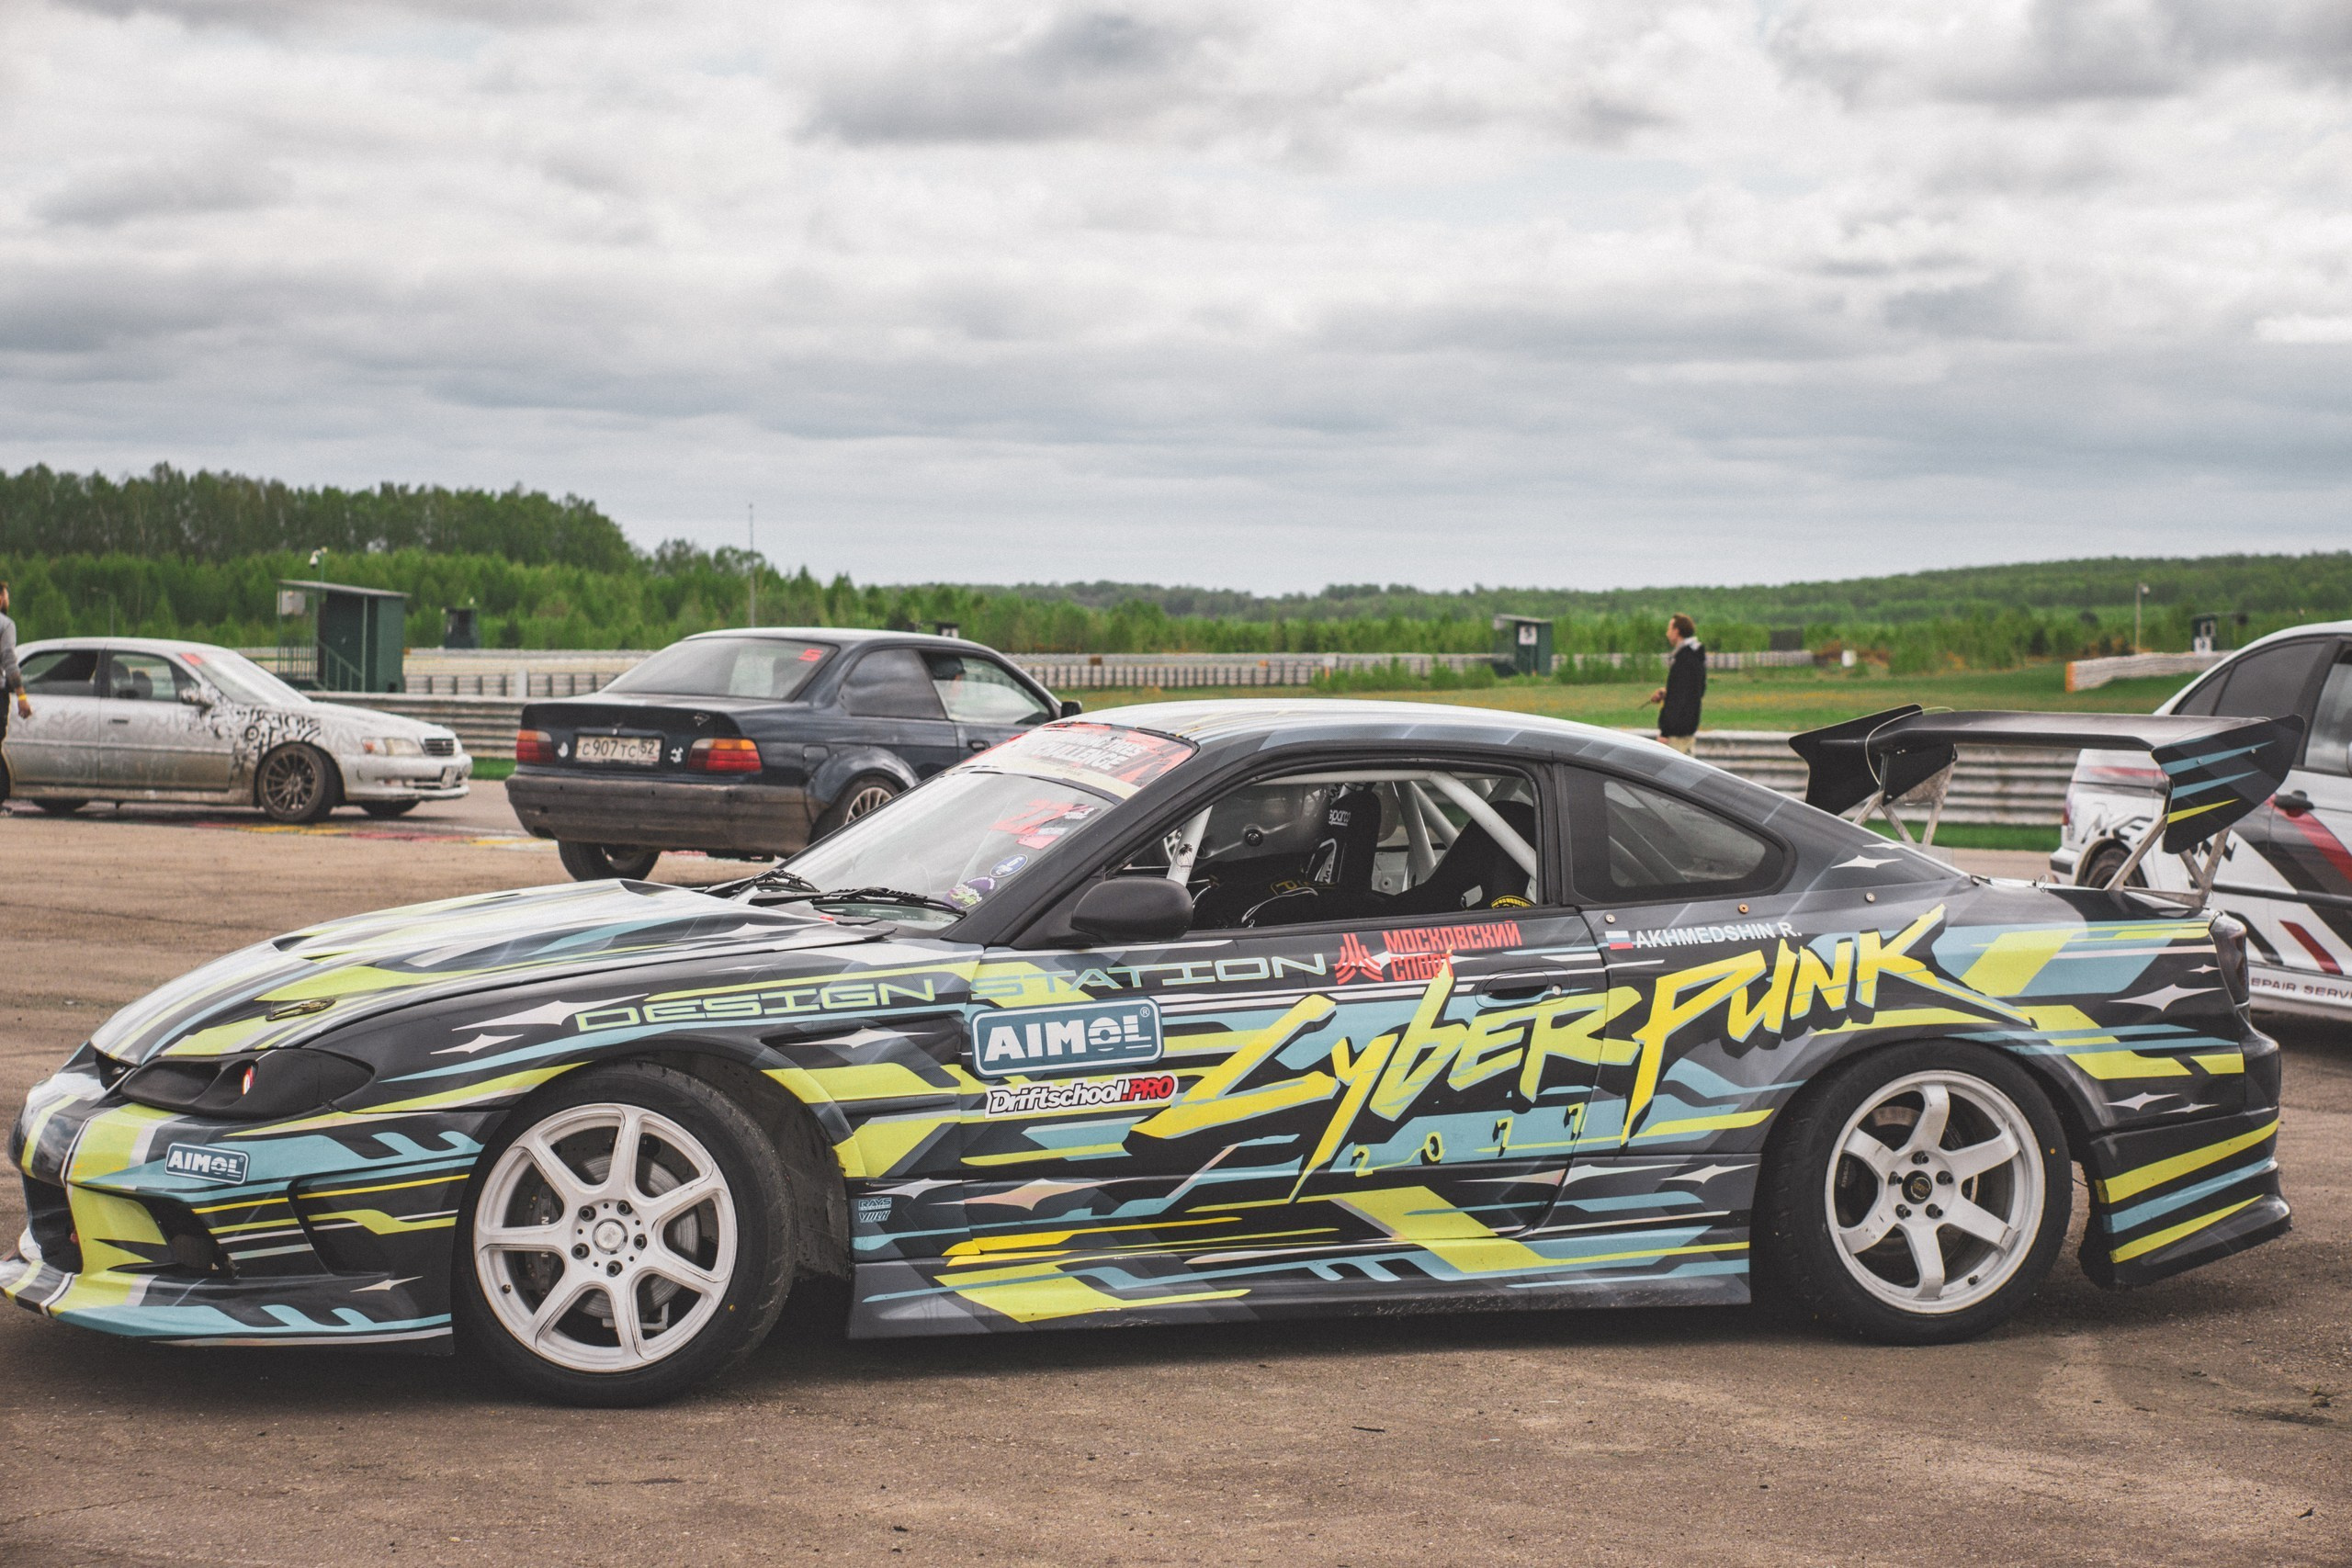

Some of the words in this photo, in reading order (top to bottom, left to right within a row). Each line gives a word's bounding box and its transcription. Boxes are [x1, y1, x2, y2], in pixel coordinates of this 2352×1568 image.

[1383, 920, 1522, 953] МОСКОВСКИЙ
[1636, 922, 1776, 948] AKHMEDSHIN
[1777, 921, 1803, 938] R.
[1390, 953, 1453, 981] СПОРТ
[575, 979, 935, 1032] DESIGN
[970, 953, 1327, 1000] STATION
[984, 1015, 1152, 1062] AIMOL
[989, 1076, 1175, 1114] Driftschool.PRO
[168, 1150, 242, 1178] AIMOL
[859, 1197, 892, 1207] RAYS
